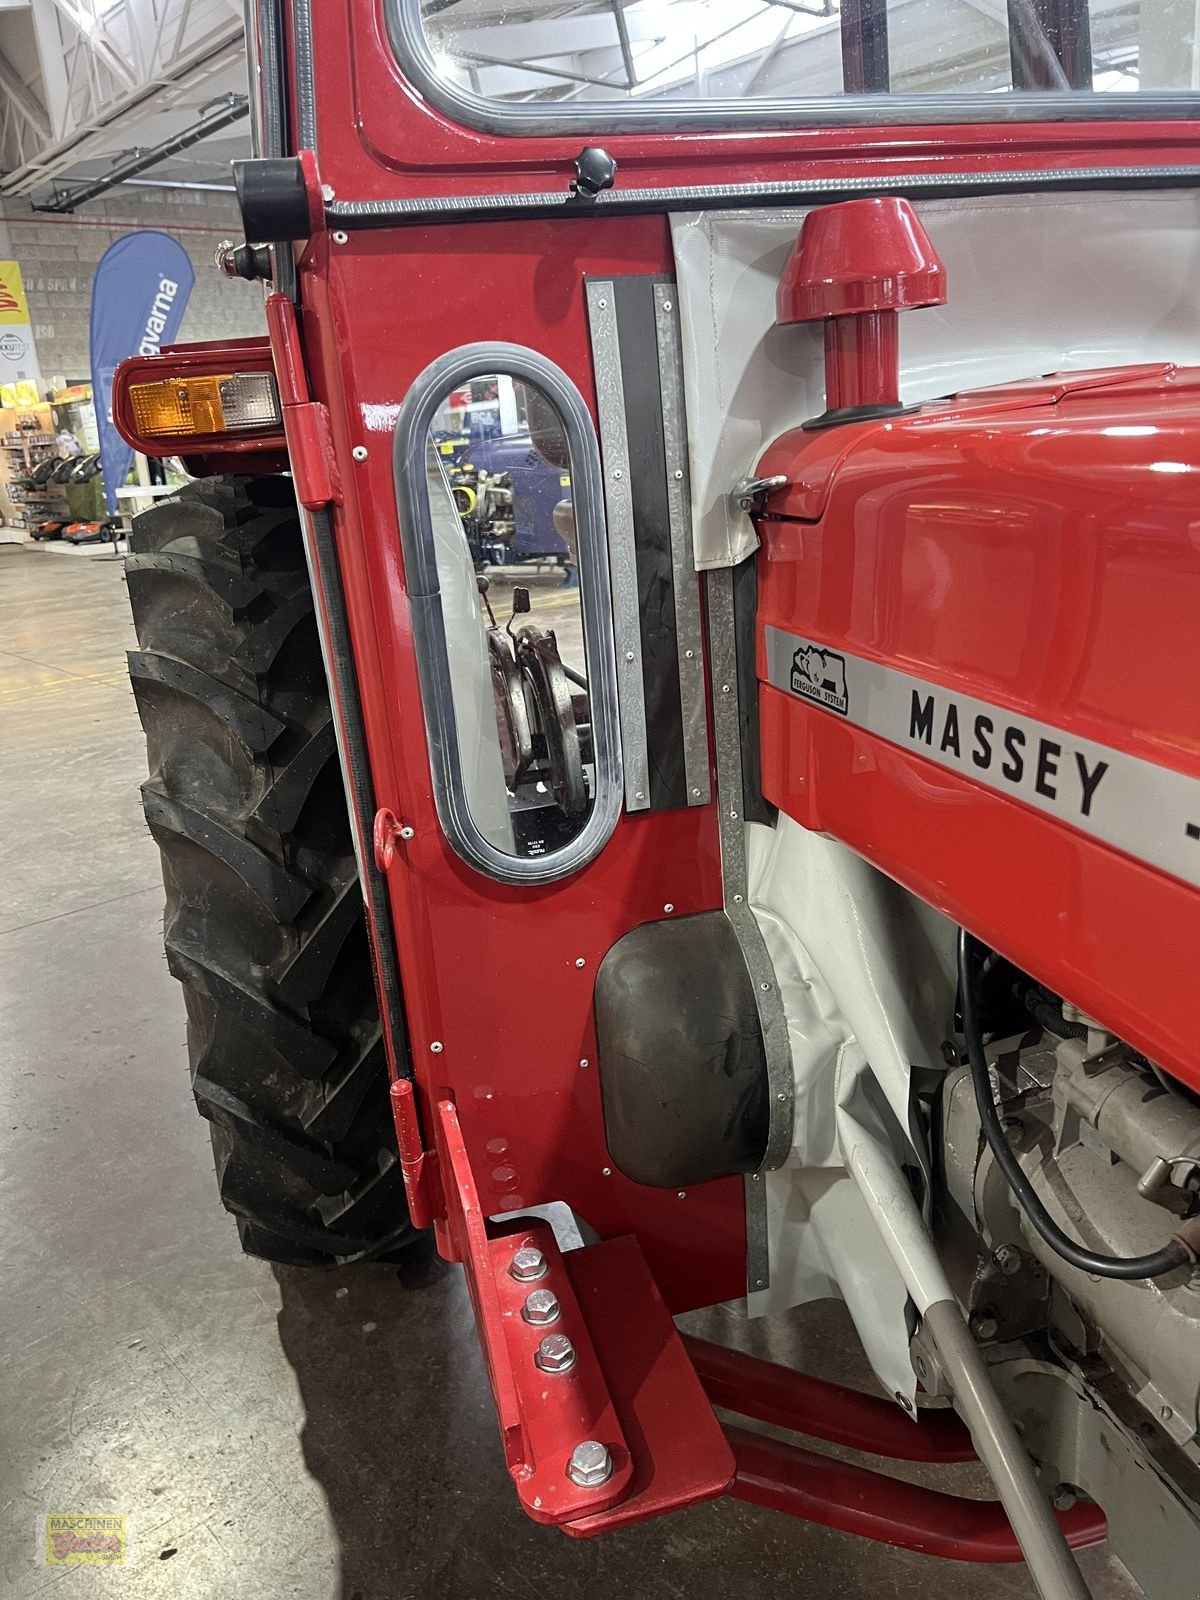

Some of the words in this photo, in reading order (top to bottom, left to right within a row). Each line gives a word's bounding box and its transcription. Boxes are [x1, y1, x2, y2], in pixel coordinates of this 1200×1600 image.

[793, 678, 821, 698] FERGUSON
[824, 692, 845, 707] SYSTEM
[908, 689, 1109, 817] MASSEY
